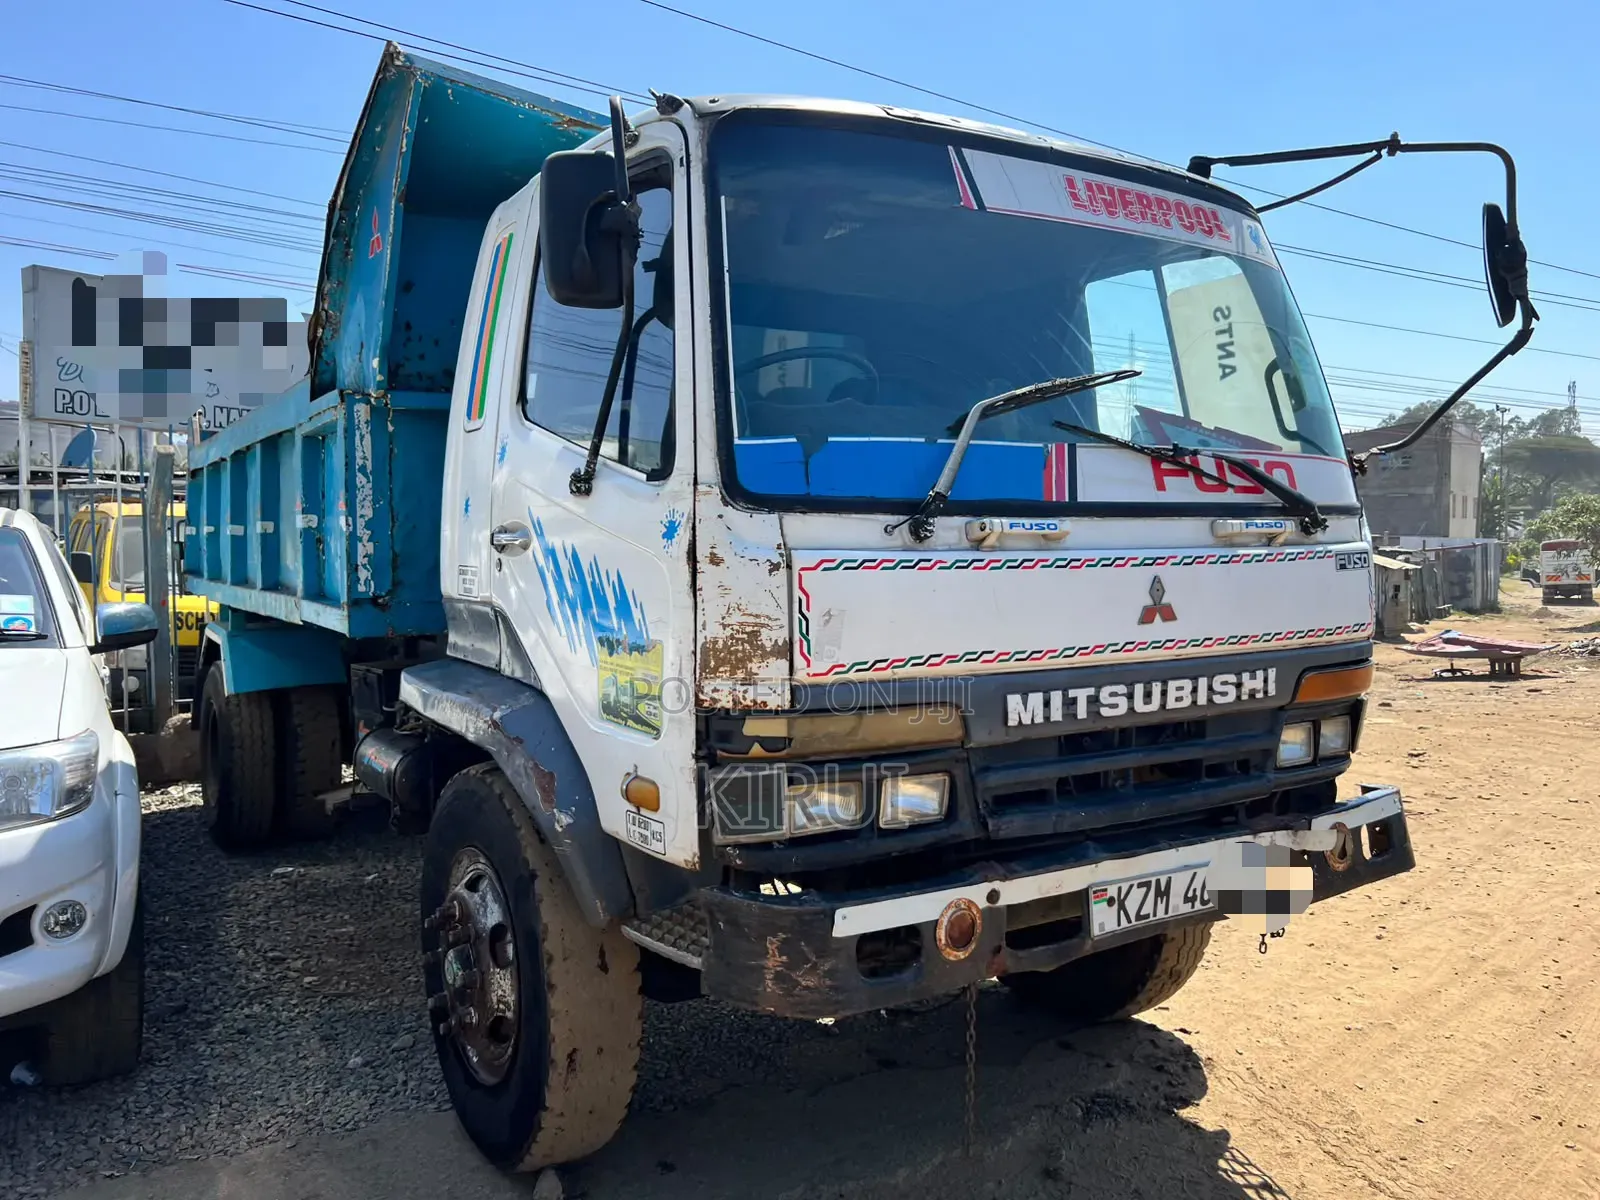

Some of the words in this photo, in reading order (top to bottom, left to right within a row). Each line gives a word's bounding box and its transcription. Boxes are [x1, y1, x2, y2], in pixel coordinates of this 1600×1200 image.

[1063, 175, 1232, 243] LIVERPOOL
[1151, 453, 1297, 495] FUSO
[1008, 521, 1059, 532] FUSO
[1244, 519, 1284, 530] FUSO
[1337, 552, 1370, 570] FUSO
[1006, 667, 1276, 728] MITSUBISHI
[1116, 875, 1172, 928] KZM
